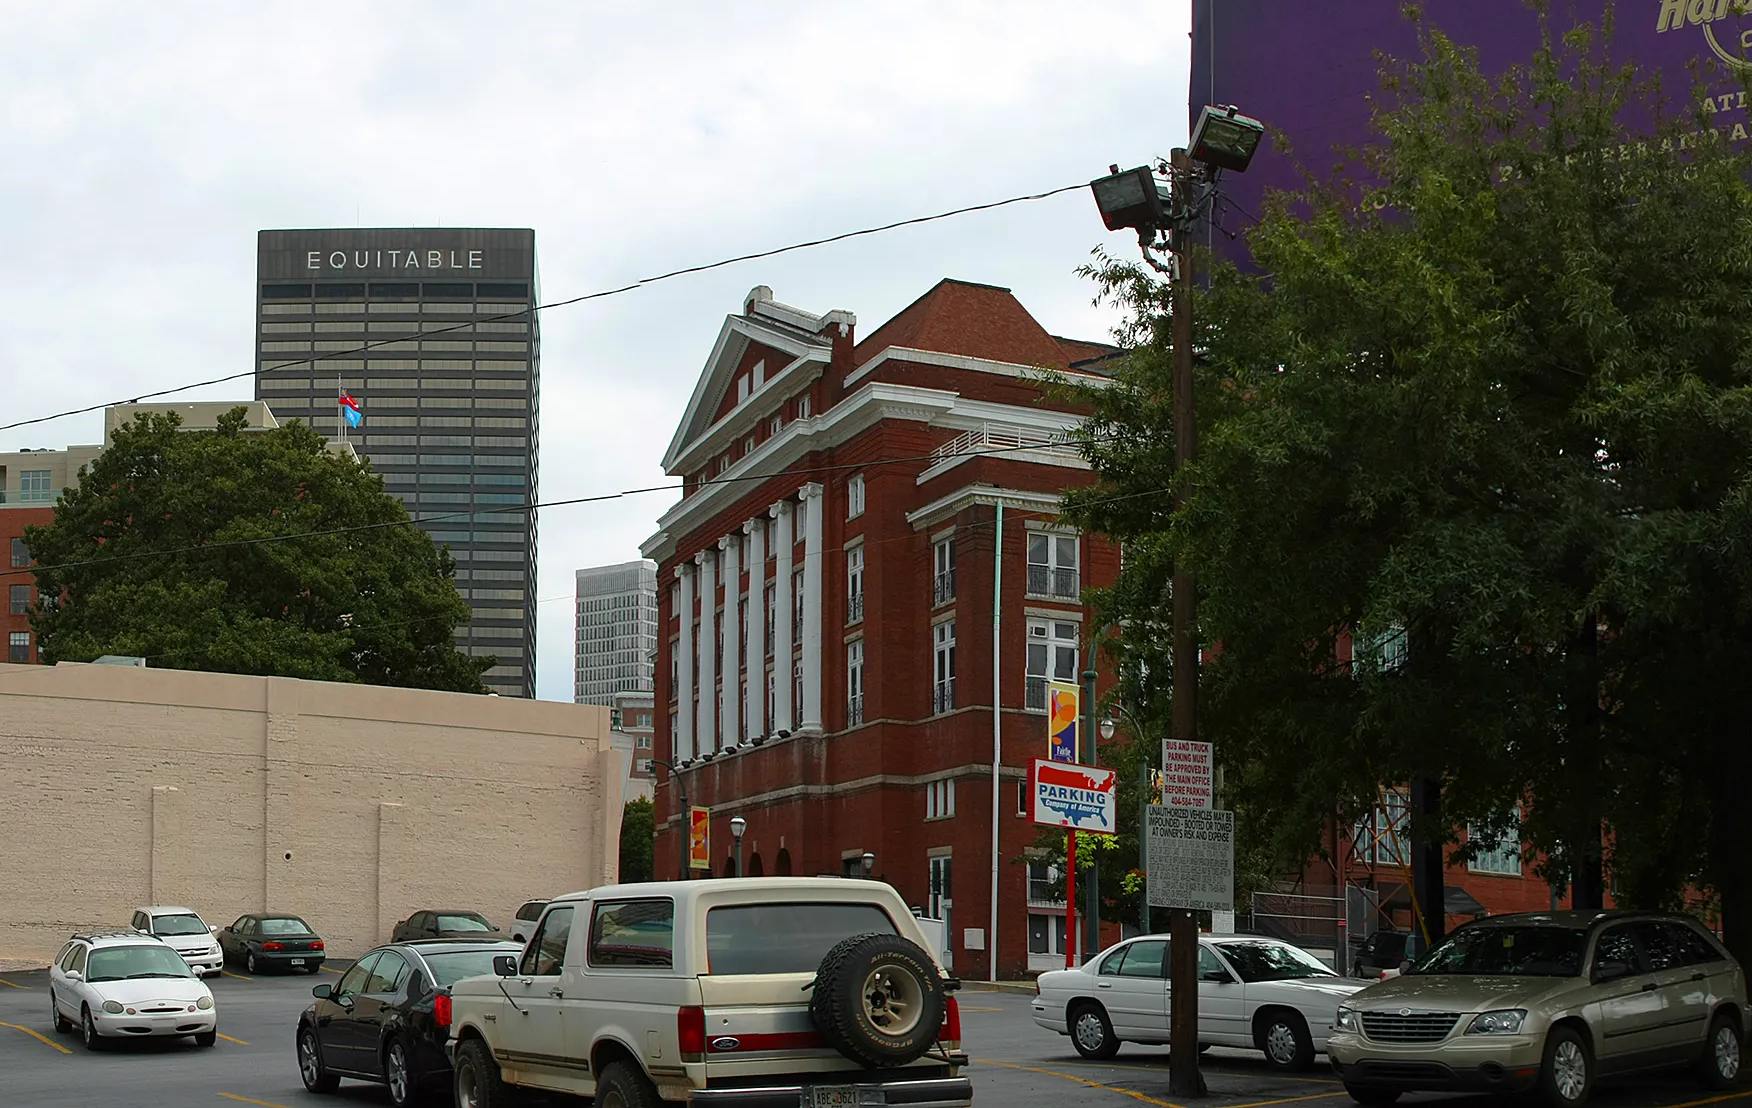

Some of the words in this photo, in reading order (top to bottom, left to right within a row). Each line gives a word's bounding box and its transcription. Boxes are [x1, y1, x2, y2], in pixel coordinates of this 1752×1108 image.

[307, 250, 483, 269] EQUITABLE
[1166, 741, 1177, 750] BUS
[1178, 742, 1189, 751] AND
[1191, 743, 1209, 753] TRUCK
[1168, 753, 1191, 762] PARKING
[1193, 754, 1207, 763] MUST
[1166, 763, 1173, 772] BE
[1174, 764, 1202, 774] APPROVED
[1202, 766, 1209, 775] BY
[1166, 774, 1176, 783] THE
[1177, 775, 1191, 784] MAIN
[1192, 777, 1210, 786] OFFICE
[1039, 784, 1106, 804] PARKING
[1165, 785, 1185, 795] BEFORE
[1045, 799, 1069, 809] Company
[1078, 804, 1100, 813] America
[1149, 806, 1189, 818] UNAUTHORIZED
[1190, 810, 1212, 821] VEHICLES
[1213, 811, 1225, 821] MAY
[1225, 812, 1232, 822] BE
[1149, 817, 1180, 828] IMPOUNDED
[1184, 819, 1204, 830] BOOTED
[1206, 821, 1213, 830] OR
[1214, 822, 1232, 832] TOWED
[1152, 827, 1158, 836] AT
[1184, 829, 1195, 839] RISK
[1196, 831, 1207, 840] AND
[1208, 832, 1230, 843] EXPENSE
[817, 1093, 831, 1105] ABE
